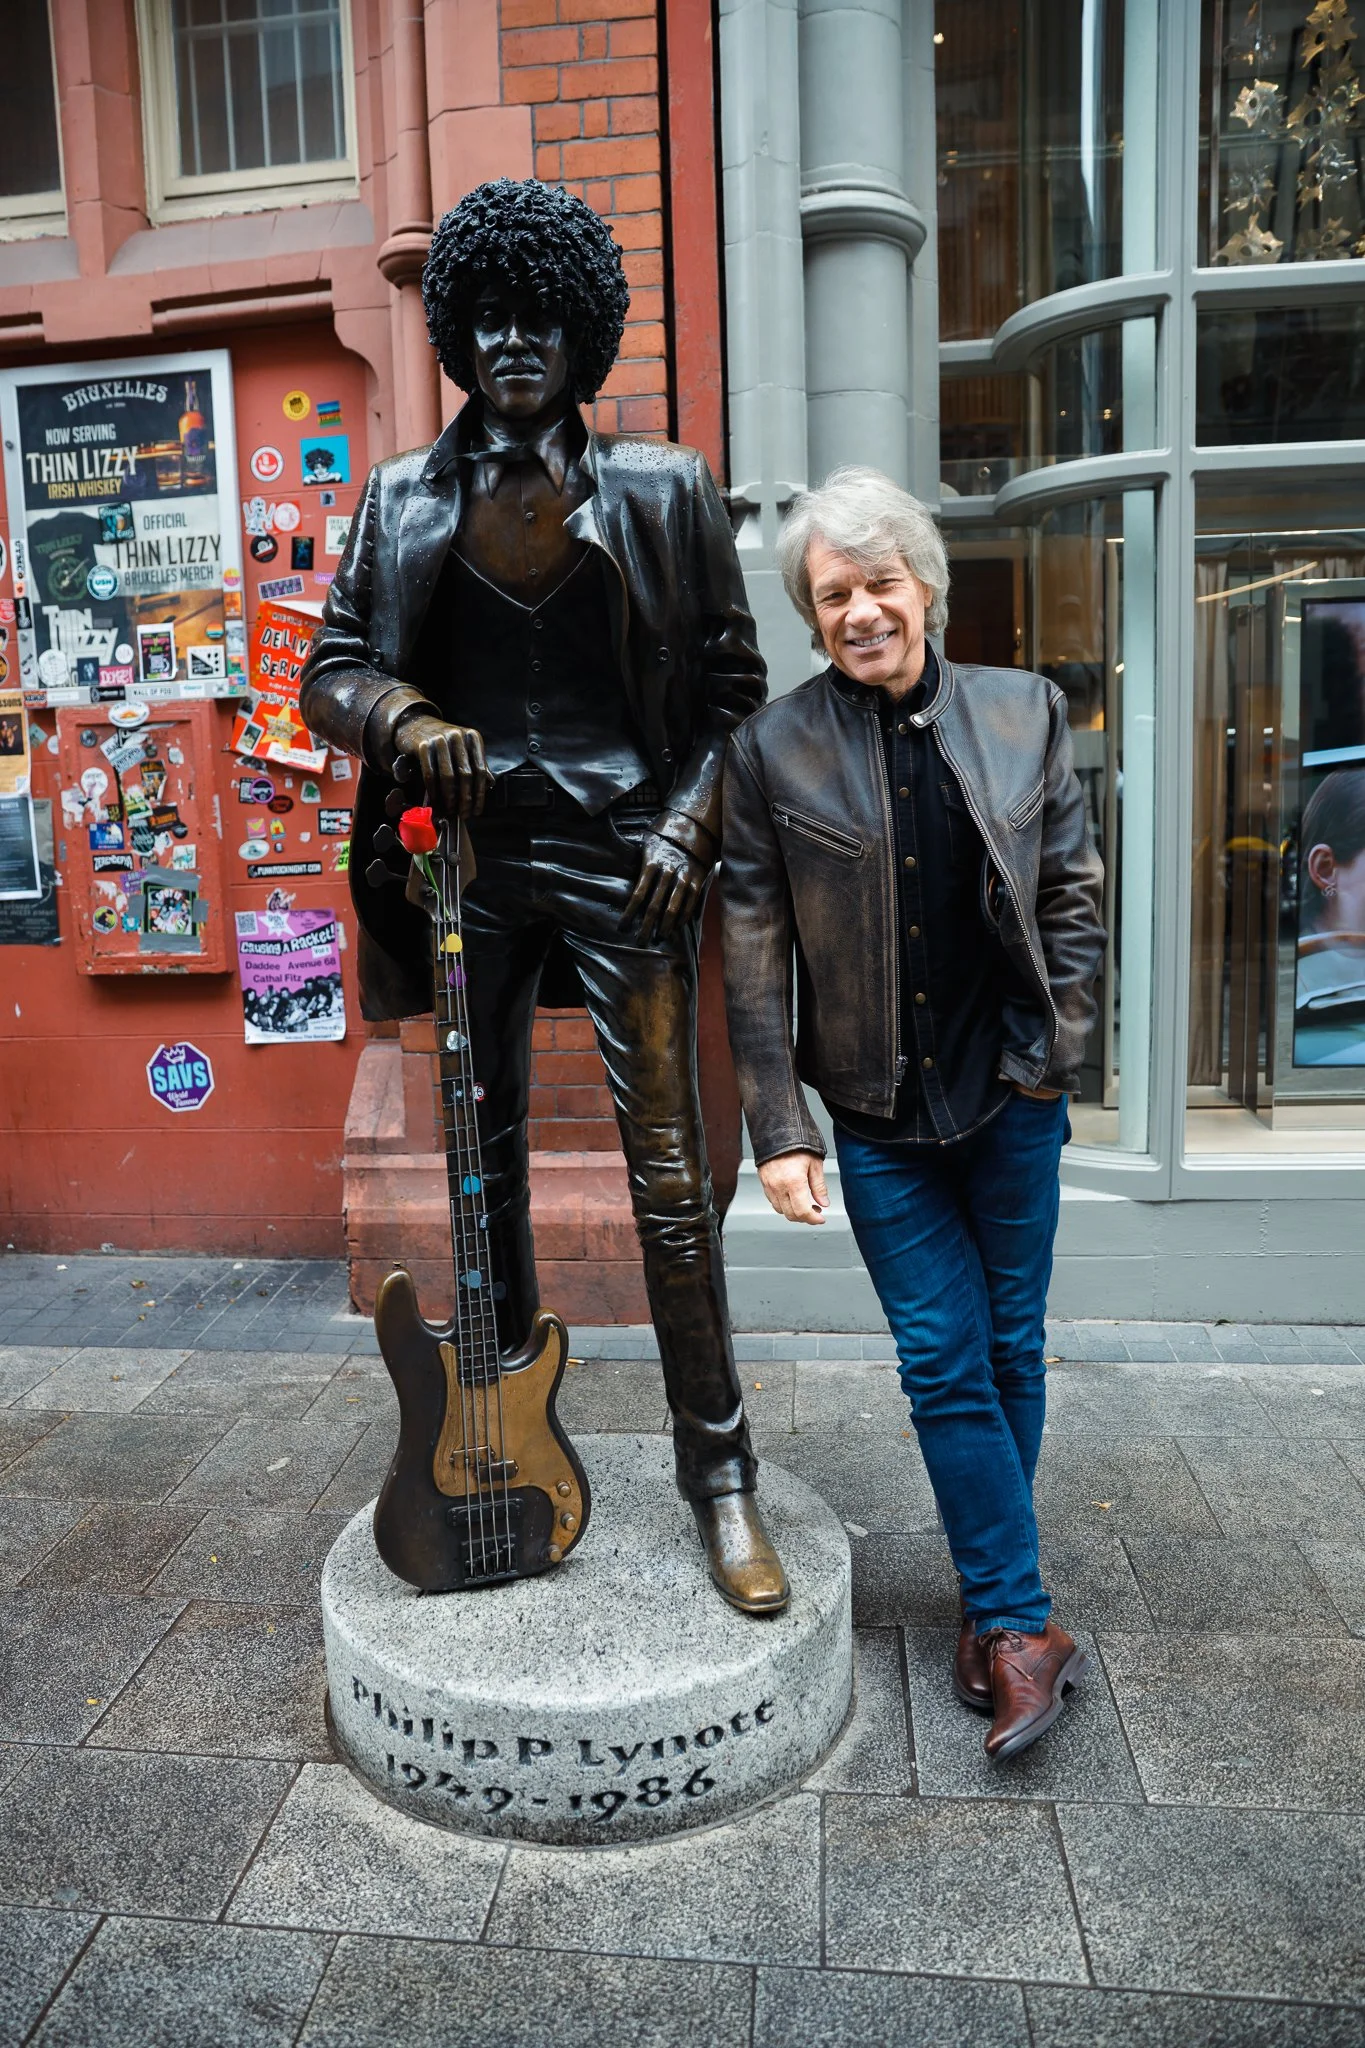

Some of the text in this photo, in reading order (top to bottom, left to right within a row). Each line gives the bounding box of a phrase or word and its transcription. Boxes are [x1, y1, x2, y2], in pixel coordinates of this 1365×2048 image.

[61, 380, 169, 412] BRUXELLES
[45, 423, 116, 446] NOW SERVING
[26, 446, 138, 484] THIN LIZZY
[48, 479, 122, 499] IRISH WHISKEY
[143, 512, 187, 530] OFFICIAL
[115, 533, 221, 569] THIN LIZZY
[124, 565, 213, 587] BRUXELLES MERCH
[260, 627, 310, 655] DELIV
[260, 654, 301, 680] SERV
[241, 941, 281, 955] Causing
[282, 945, 291, 954] A
[290, 923, 335, 952] Racket!
[245, 960, 280, 970] Daddee
[288, 957, 337, 970] Avenue 68
[253, 973, 302, 983] Cathal Fitz
[152, 1060, 209, 1093] SAVS
[352, 1674, 776, 1778] Philip P Lynott
[386, 1752, 515, 1816] 1949
[567, 1764, 719, 1825] 1986
